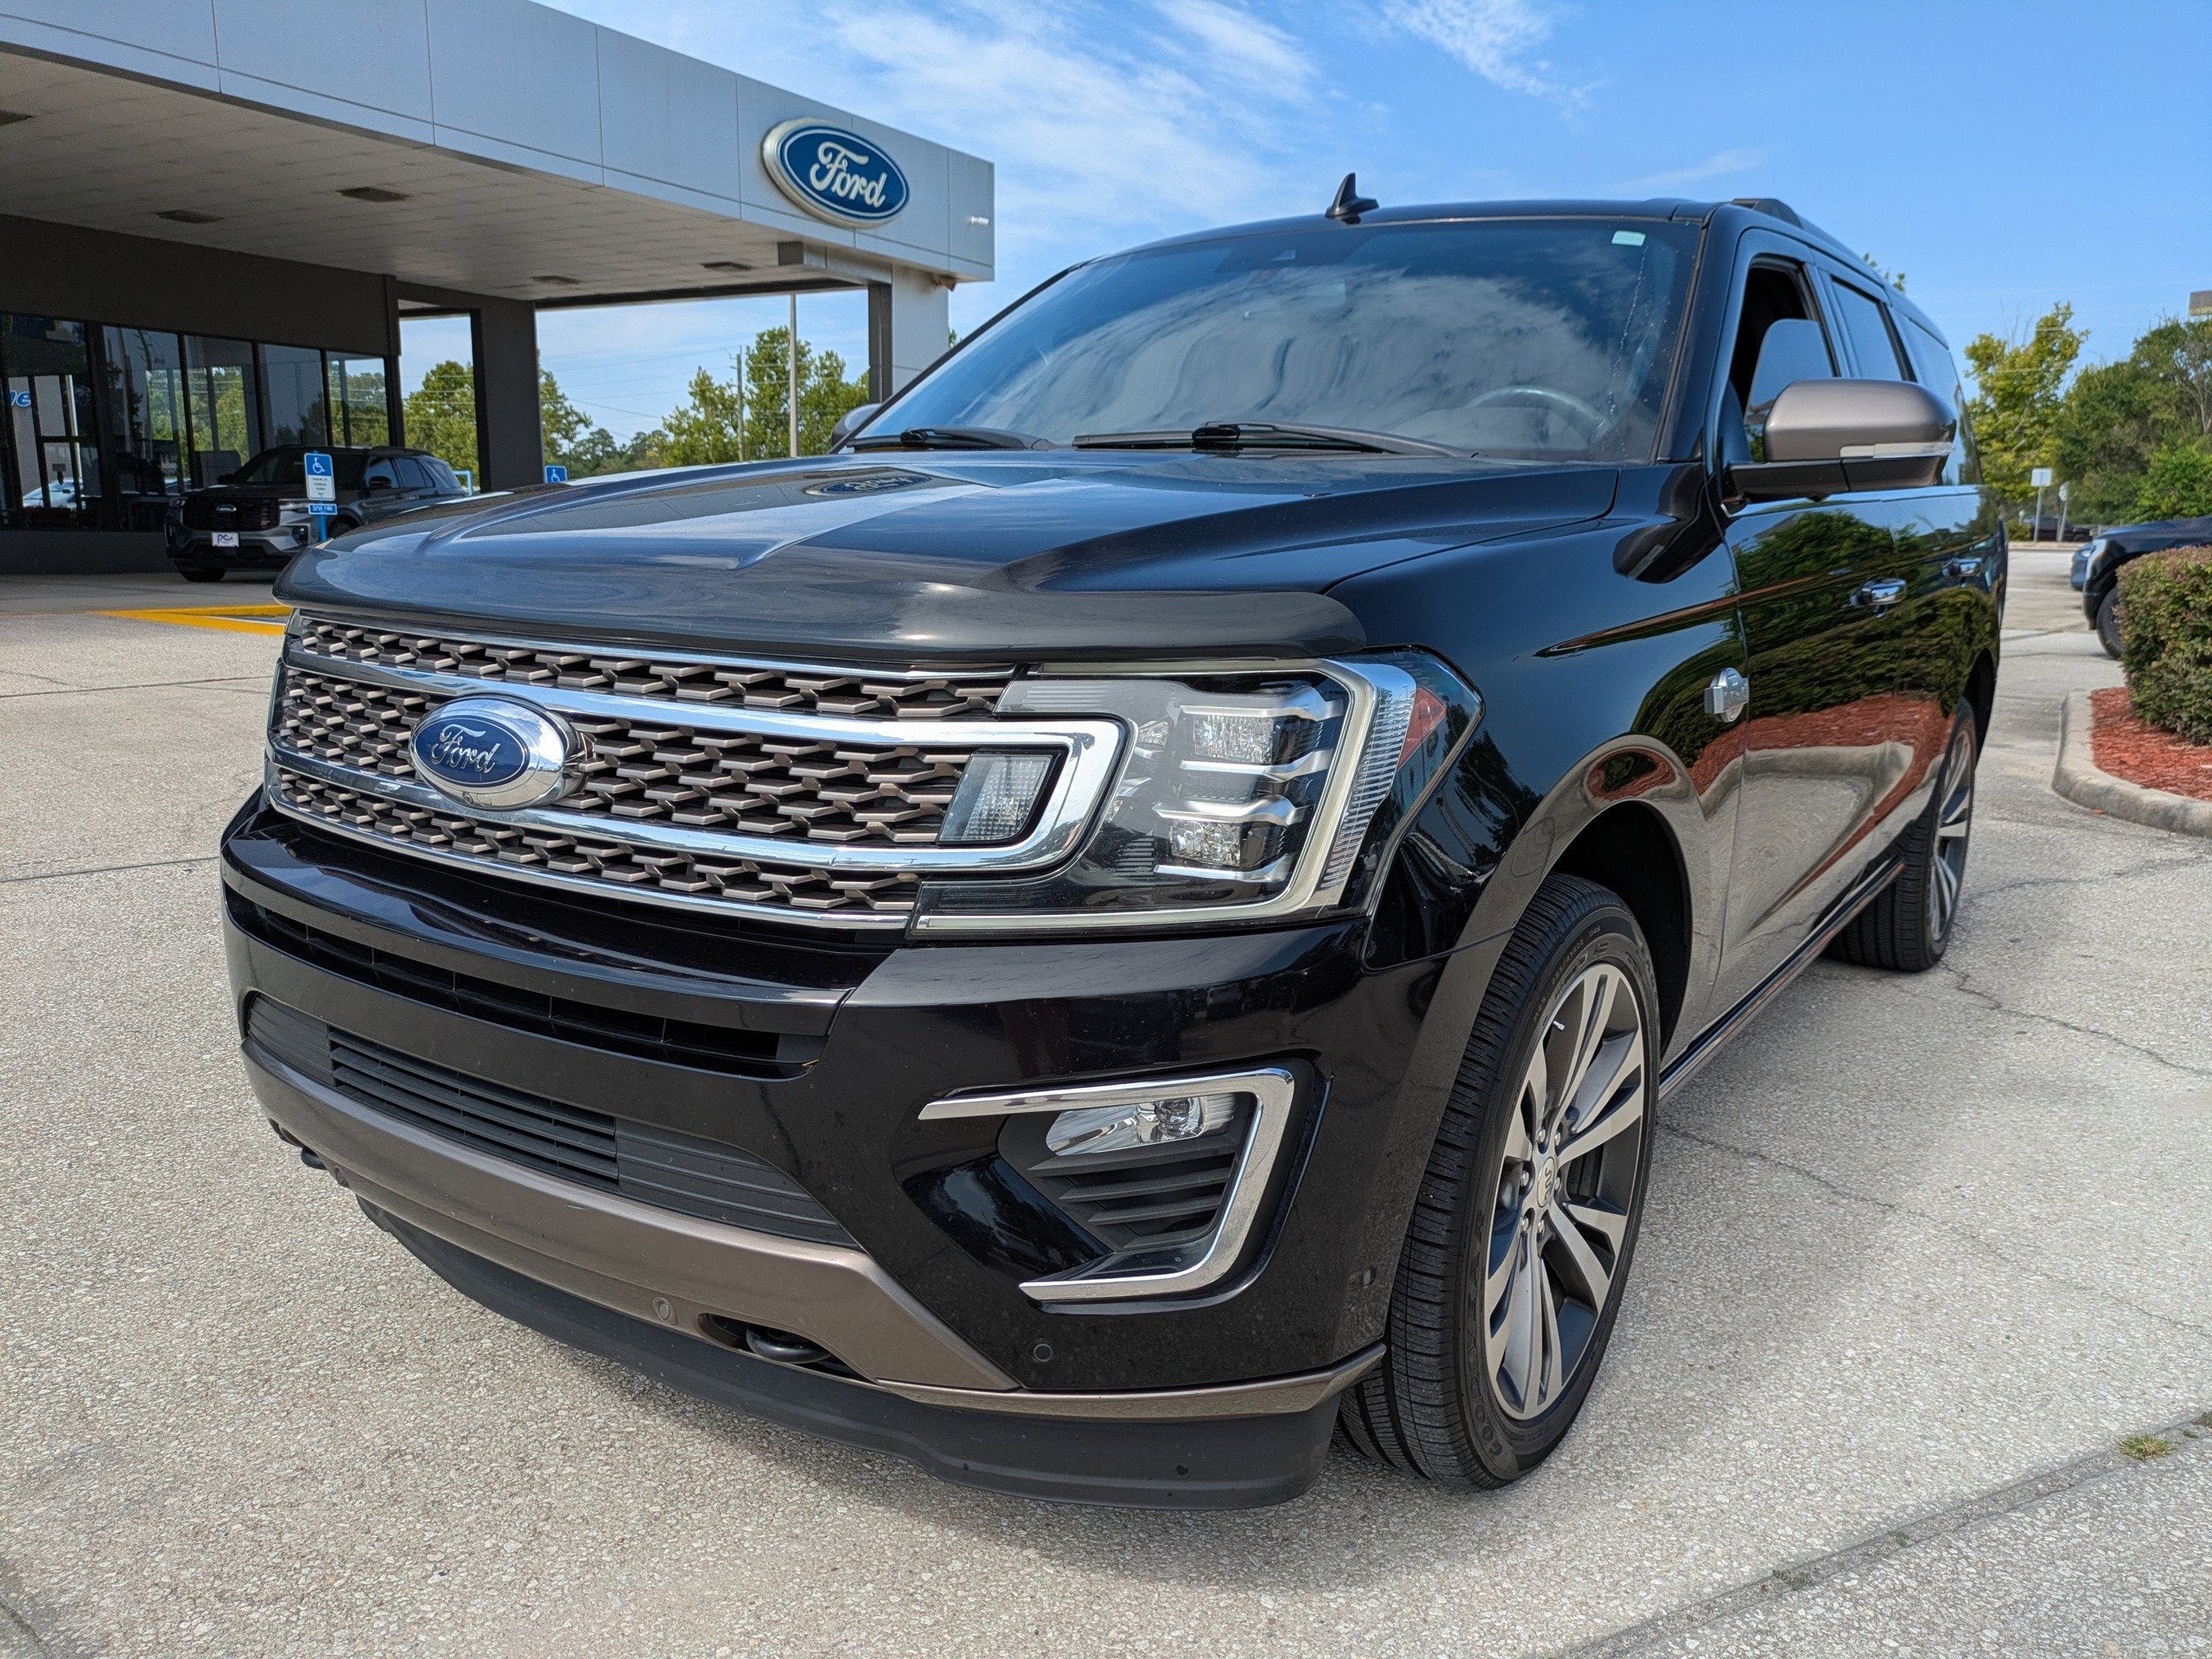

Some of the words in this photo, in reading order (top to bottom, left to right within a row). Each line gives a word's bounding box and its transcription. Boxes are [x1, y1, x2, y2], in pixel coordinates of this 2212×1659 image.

[809, 141, 888, 207] Ford
[430, 723, 501, 774] Ford
[1465, 1210, 1503, 1458] GOODYEAR
